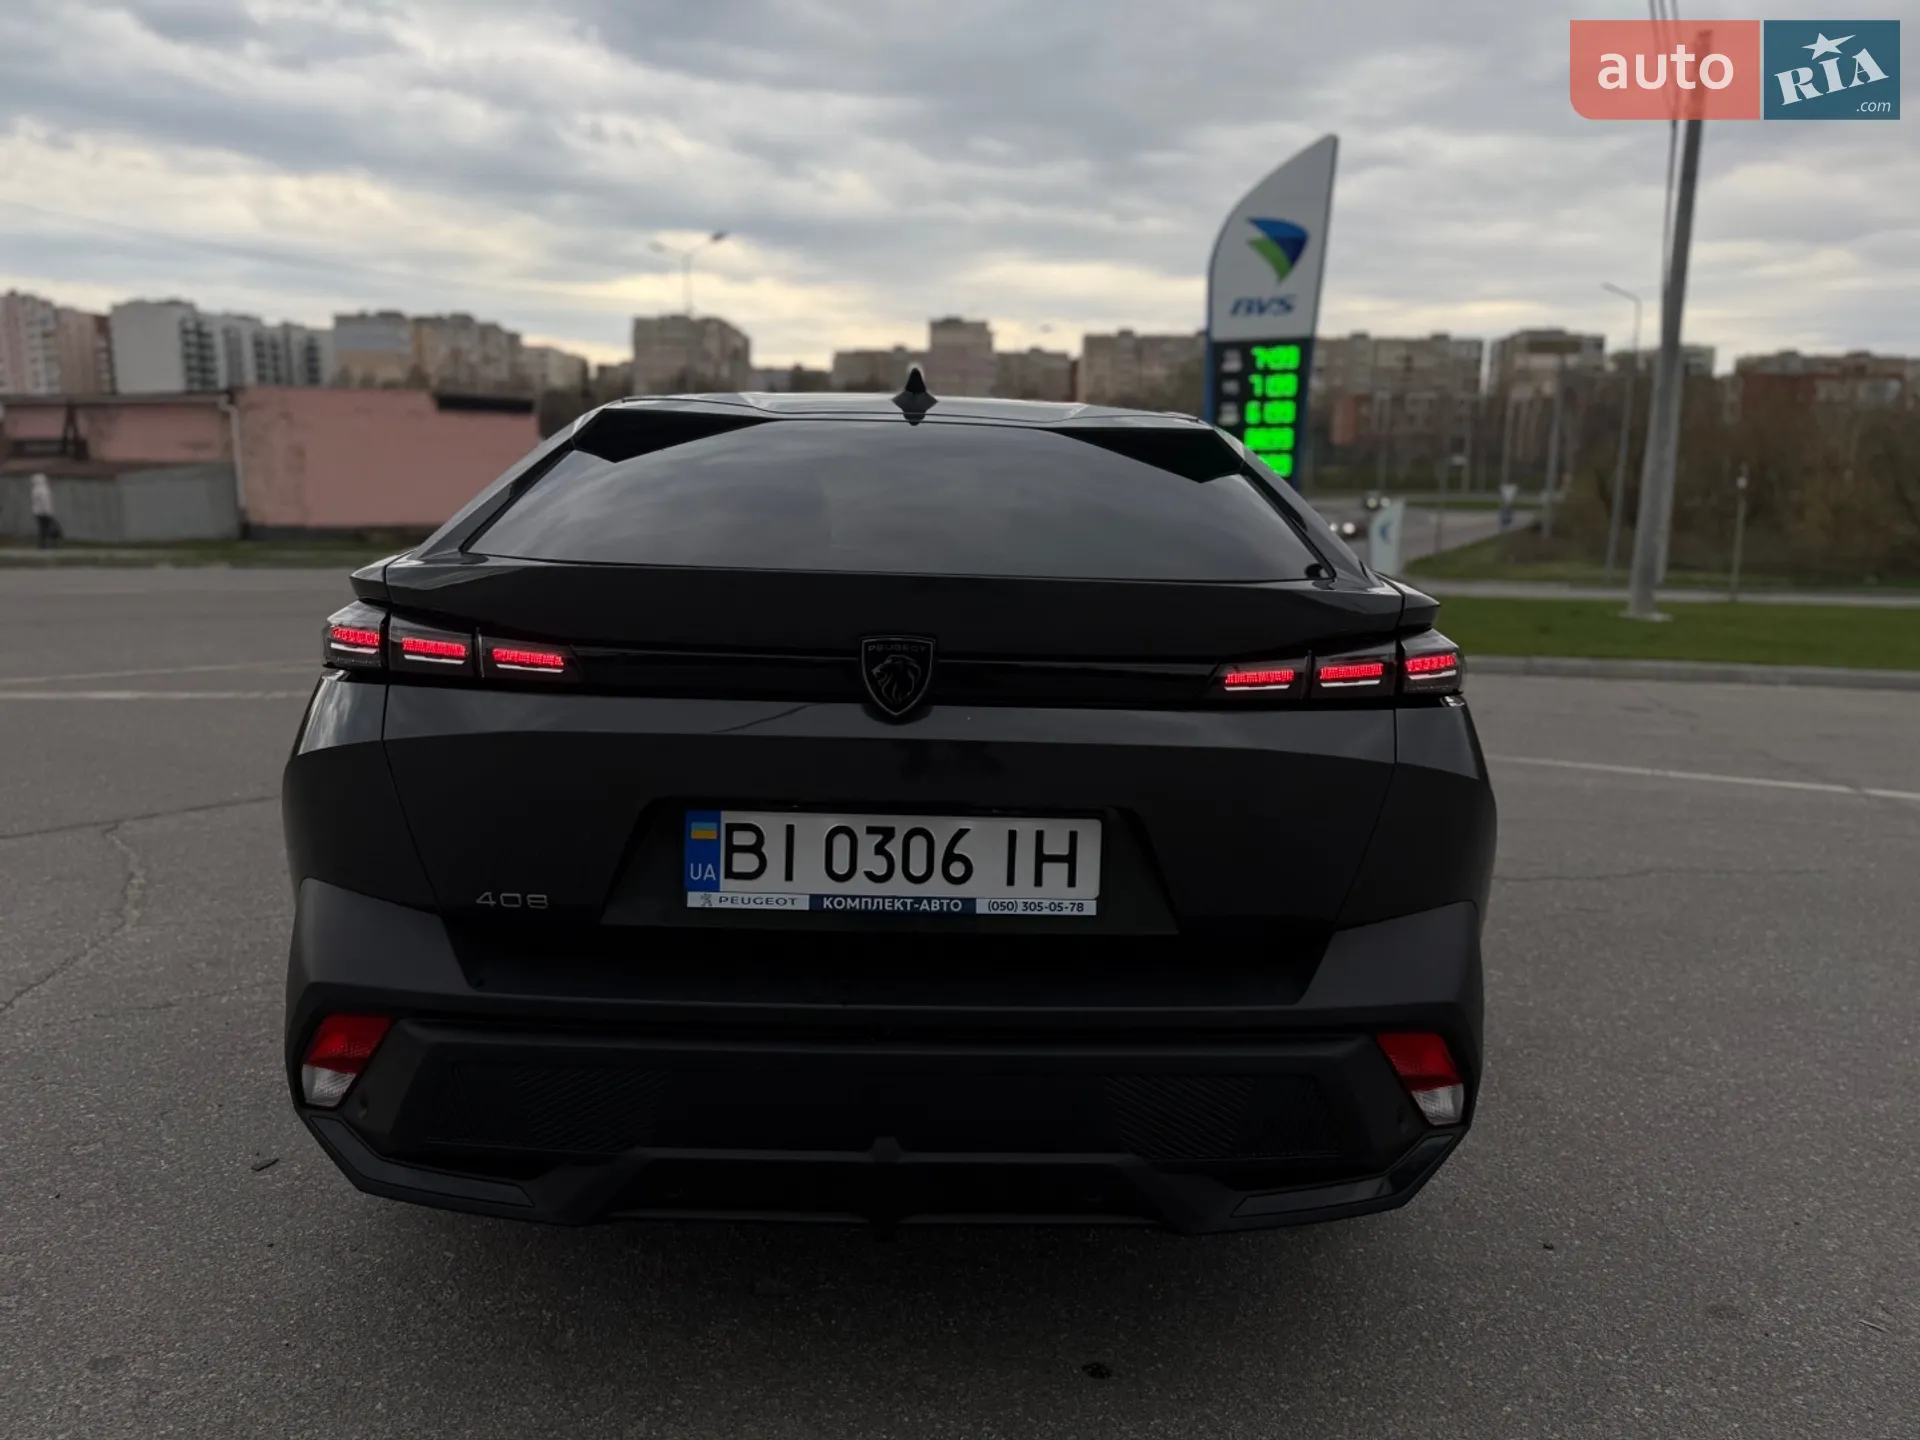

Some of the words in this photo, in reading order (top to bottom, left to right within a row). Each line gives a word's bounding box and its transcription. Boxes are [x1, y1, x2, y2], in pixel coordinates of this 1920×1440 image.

[724, 822, 795, 881] BI
[824, 825, 974, 885] 0306
[1006, 829, 1078, 888] IH
[690, 863, 717, 881] UA
[476, 892, 549, 909] 408
[718, 895, 797, 907] PEUGEOT
[822, 897, 963, 912] КОМПЛЕКТ-АВТО
[987, 900, 1018, 913] (050)
[1022, 901, 1084, 913] 305-05-78
